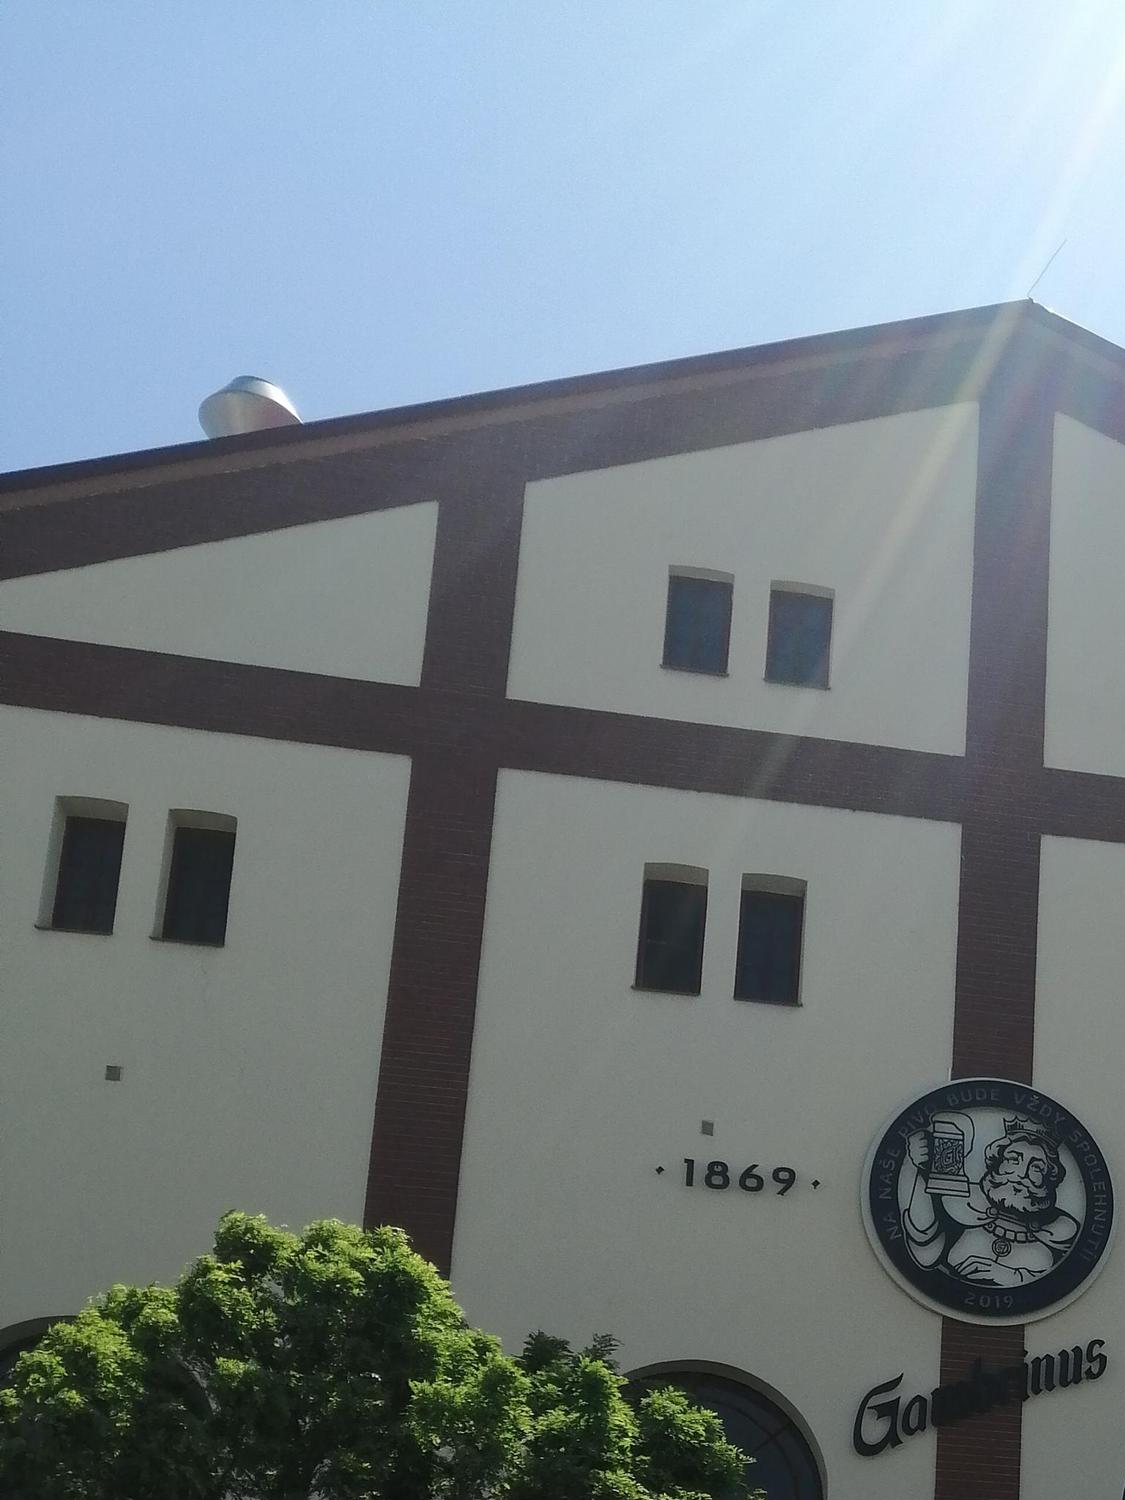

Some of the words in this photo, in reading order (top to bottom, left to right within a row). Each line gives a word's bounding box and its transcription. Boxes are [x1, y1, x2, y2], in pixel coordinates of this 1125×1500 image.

[947, 1087, 1001, 1107] BUDE
[1013, 1092, 1067, 1124] VŽDY
[898, 1102, 938, 1140] PIVO
[682, 1157, 798, 1197] 1869
[879, 1147, 902, 1200] NAŠE
[883, 1211, 903, 1241] NA
[963, 1290, 1015, 1310] 2019
